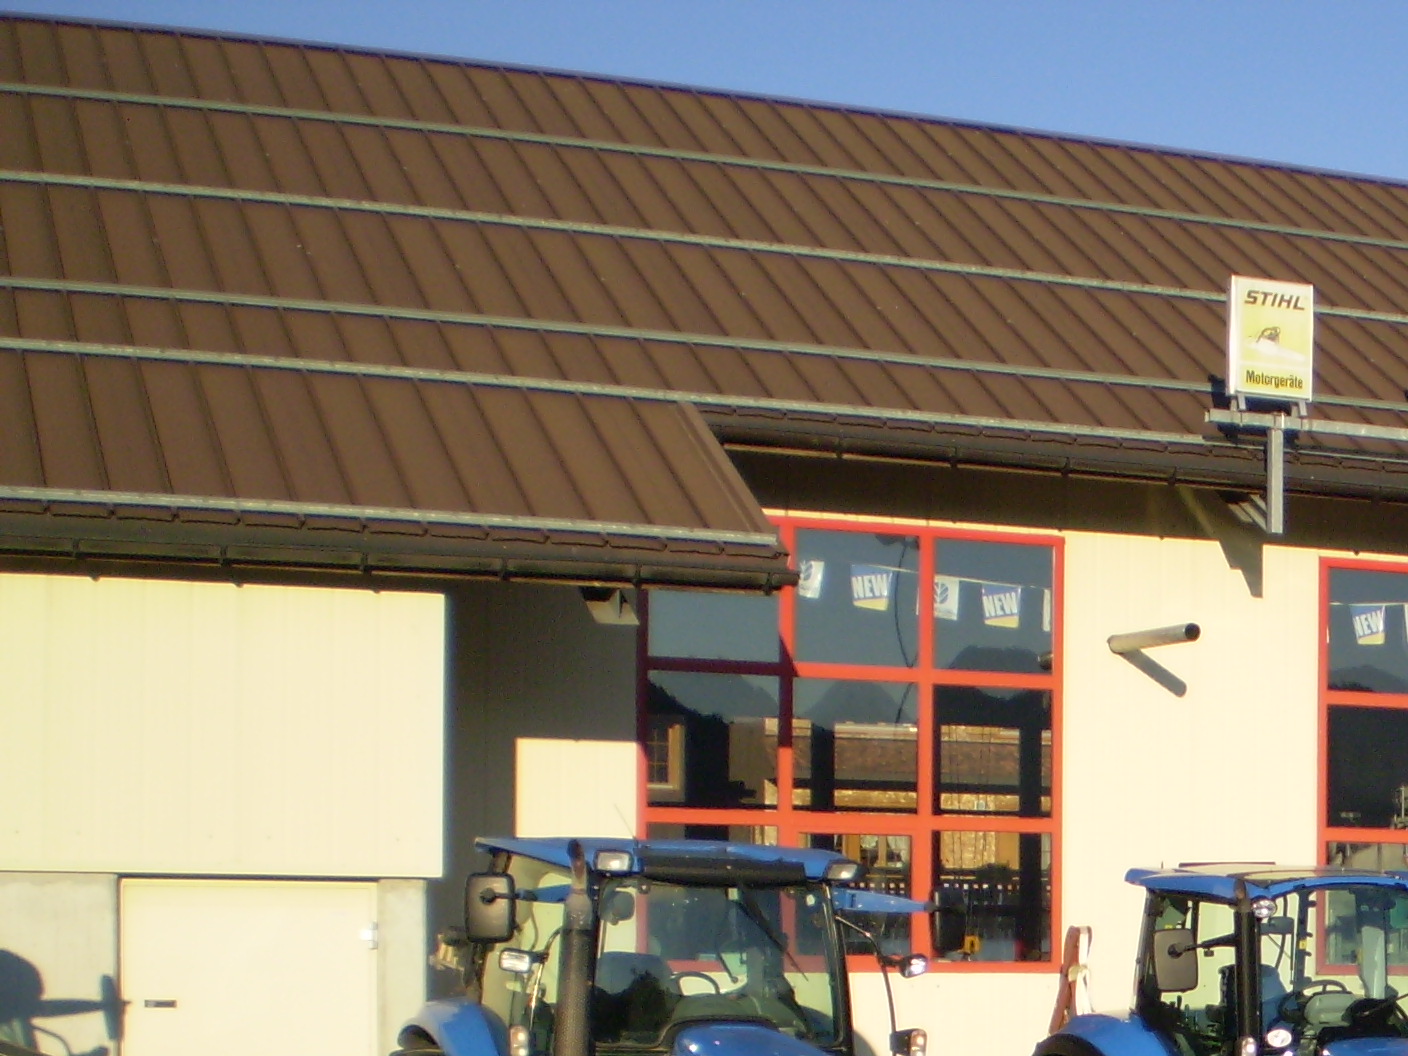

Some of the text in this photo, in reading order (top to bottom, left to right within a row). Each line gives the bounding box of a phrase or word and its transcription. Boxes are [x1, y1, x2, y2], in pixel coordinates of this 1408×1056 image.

[1244, 290, 1305, 311] STIHL
[1246, 369, 1303, 389] Motorgeräte
[852, 574, 888, 599] NEW
[983, 592, 1018, 618] NEW
[1352, 609, 1383, 637] NEW
